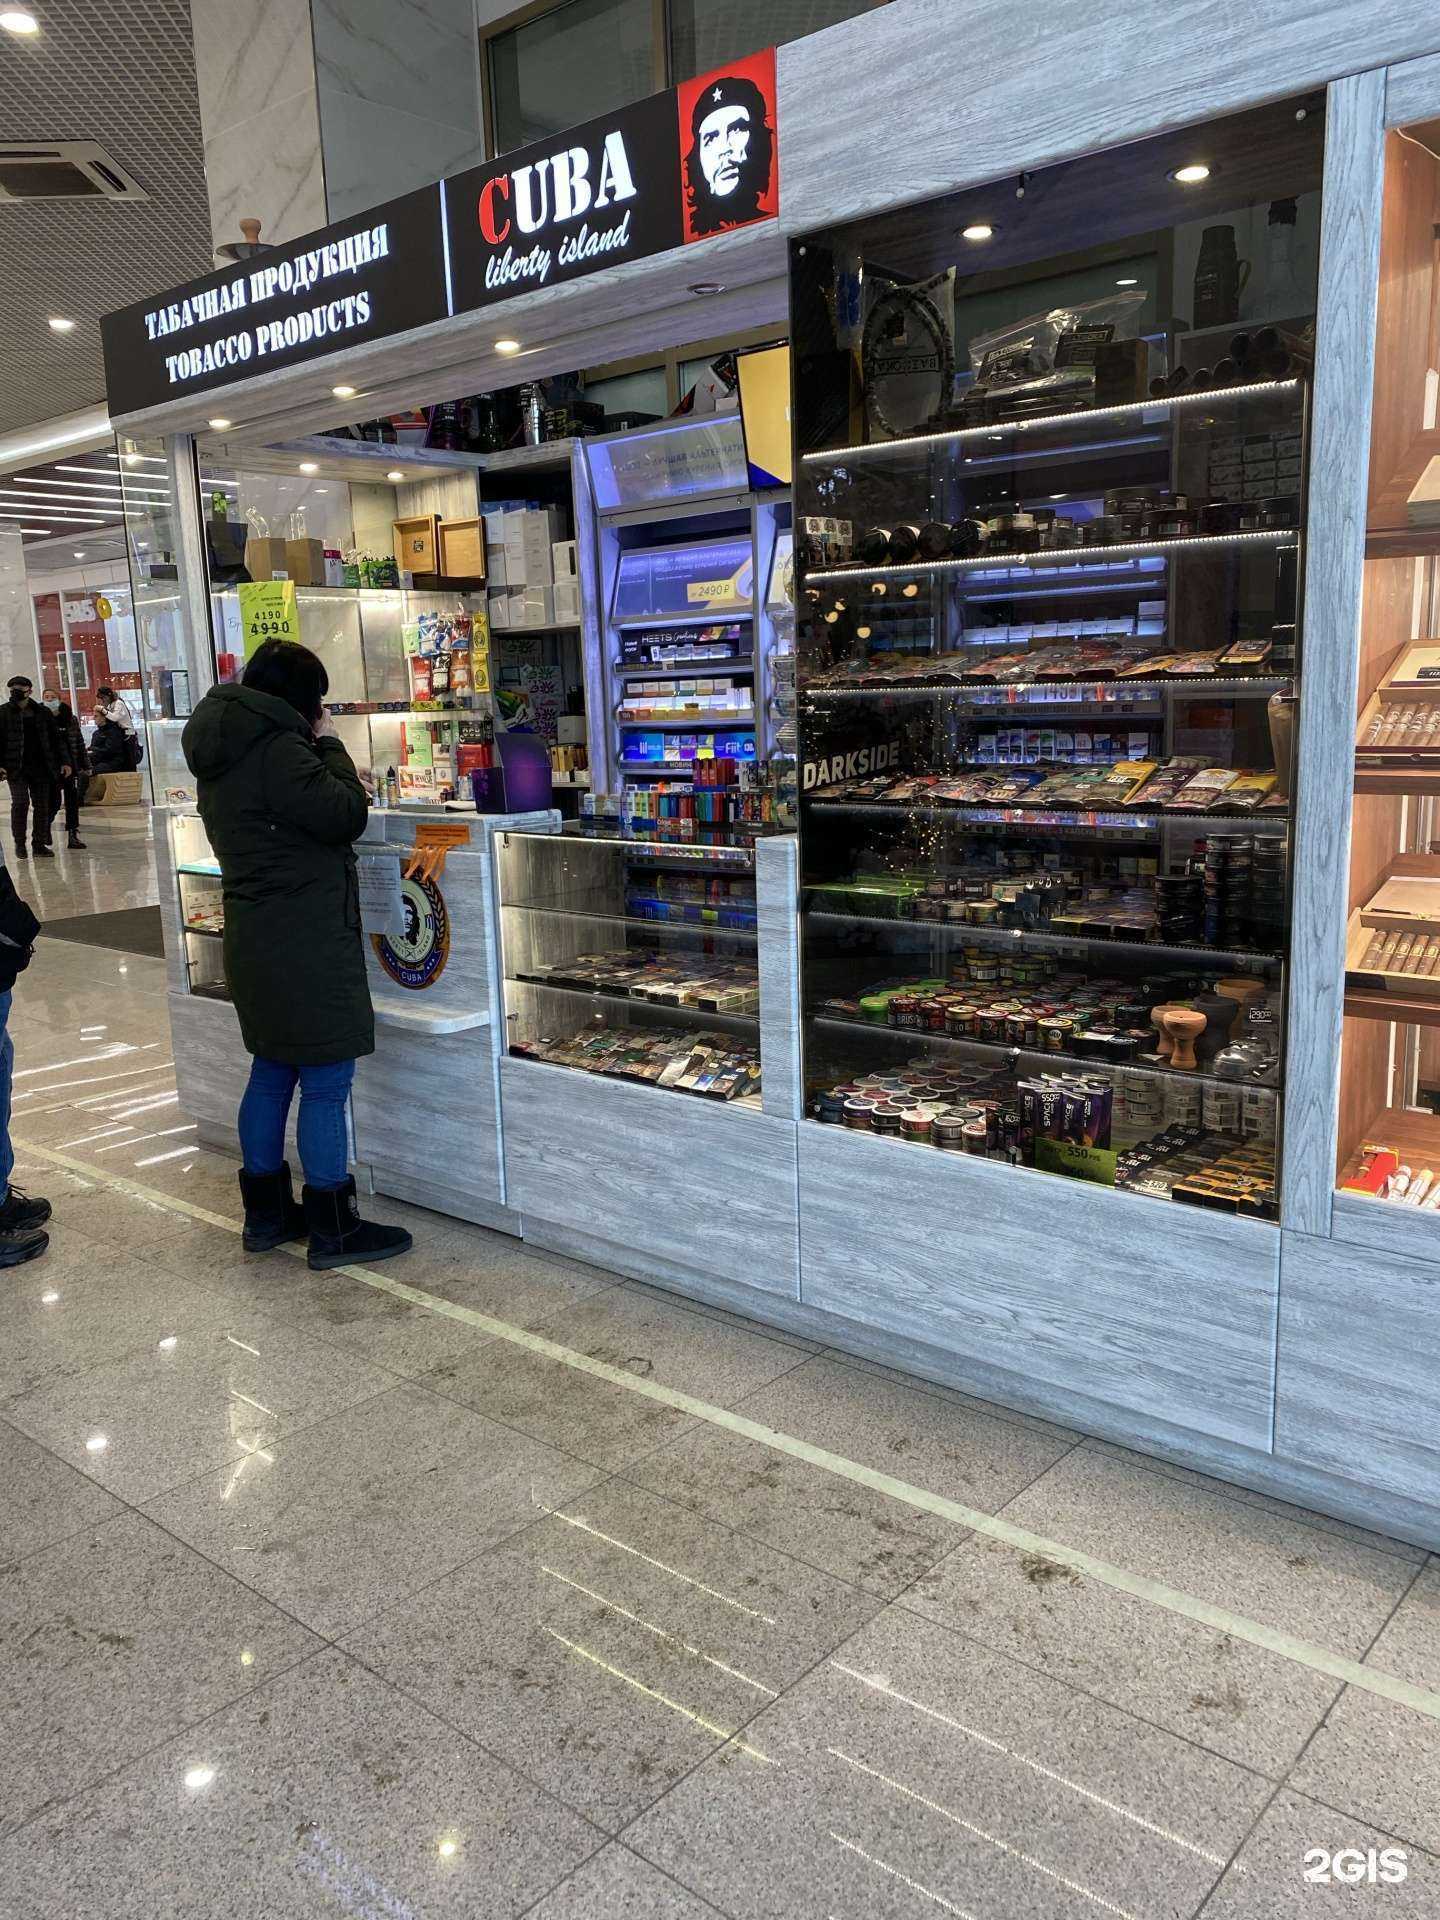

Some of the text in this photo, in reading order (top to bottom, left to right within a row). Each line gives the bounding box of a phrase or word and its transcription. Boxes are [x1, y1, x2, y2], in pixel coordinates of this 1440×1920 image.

[477, 129, 638, 247] CUBA
[484, 209, 631, 290] liberty island
[144, 222, 390, 341] ТАБАЧНАЯ ПРОДУКЦИЯ
[164, 290, 371, 384] TOBACCO PRODUCTS
[250, 620, 290, 636] 4990
[254, 610, 281, 620] 4190
[642, 631, 673, 643] HEETS
[803, 740, 900, 790] DARKSIDE
[401, 971, 423, 982] CUBA
[1067, 1146, 1088, 1158] 550
